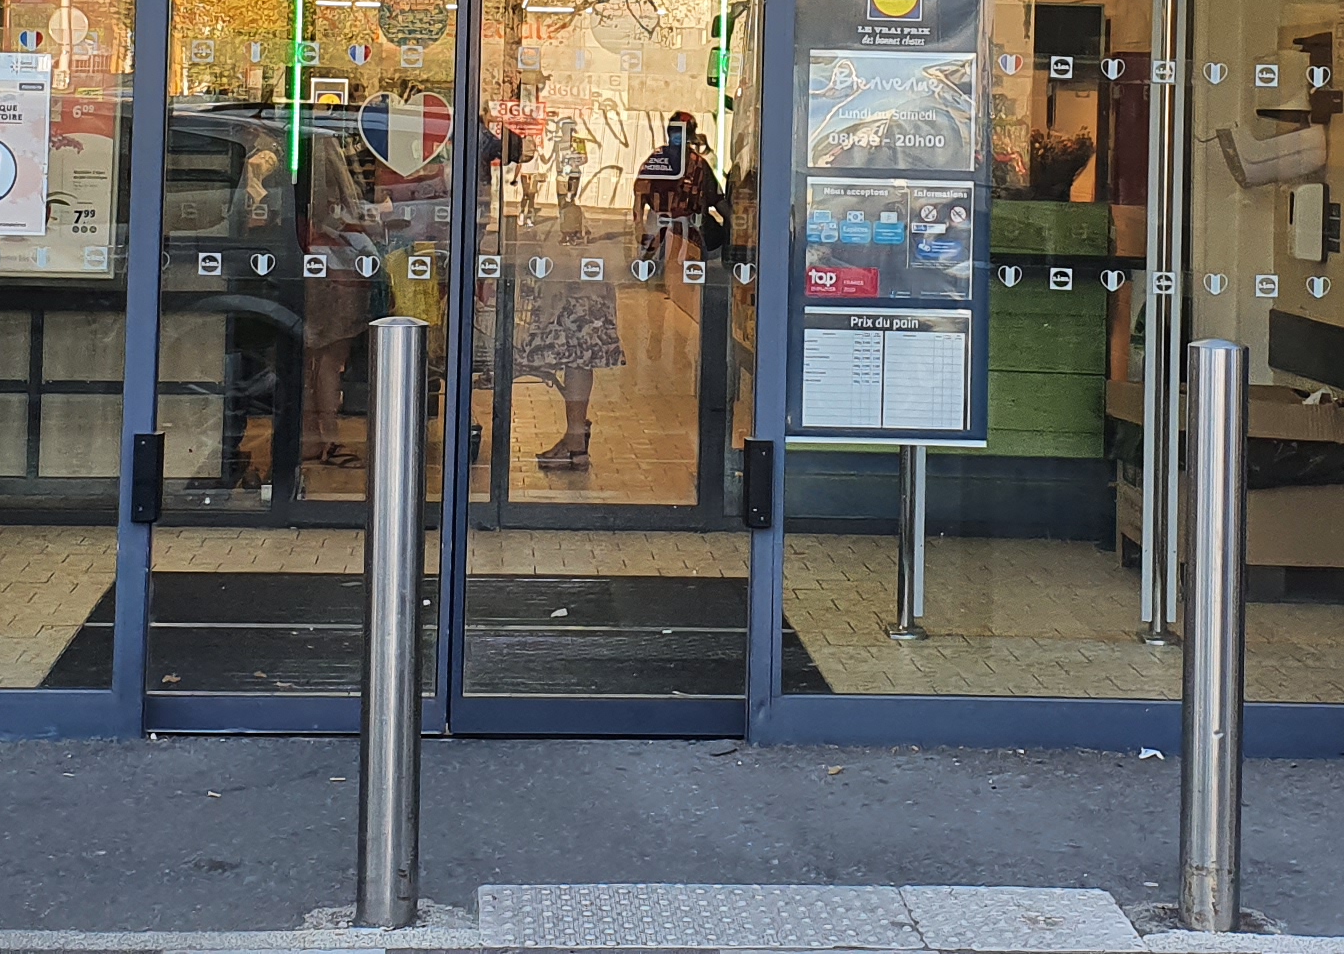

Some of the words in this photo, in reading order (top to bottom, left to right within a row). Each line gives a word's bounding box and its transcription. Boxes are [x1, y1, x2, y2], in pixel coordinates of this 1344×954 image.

[857, 25, 872, 33] LE
[873, 26, 901, 34] VRAI
[903, 27, 931, 35] PRIX
[835, 67, 943, 92] Bienvenue
[838, 108, 871, 119] Lundi
[892, 109, 937, 121] Samedi
[895, 133, 945, 147] 20h00
[823, 187, 844, 196] Nous
[846, 189, 889, 198] acceptons
[913, 189, 968, 199] Informations
[808, 268, 837, 287] top
[850, 316, 873, 328] Prix
[875, 317, 890, 328] du
[892, 317, 919, 330] pain
